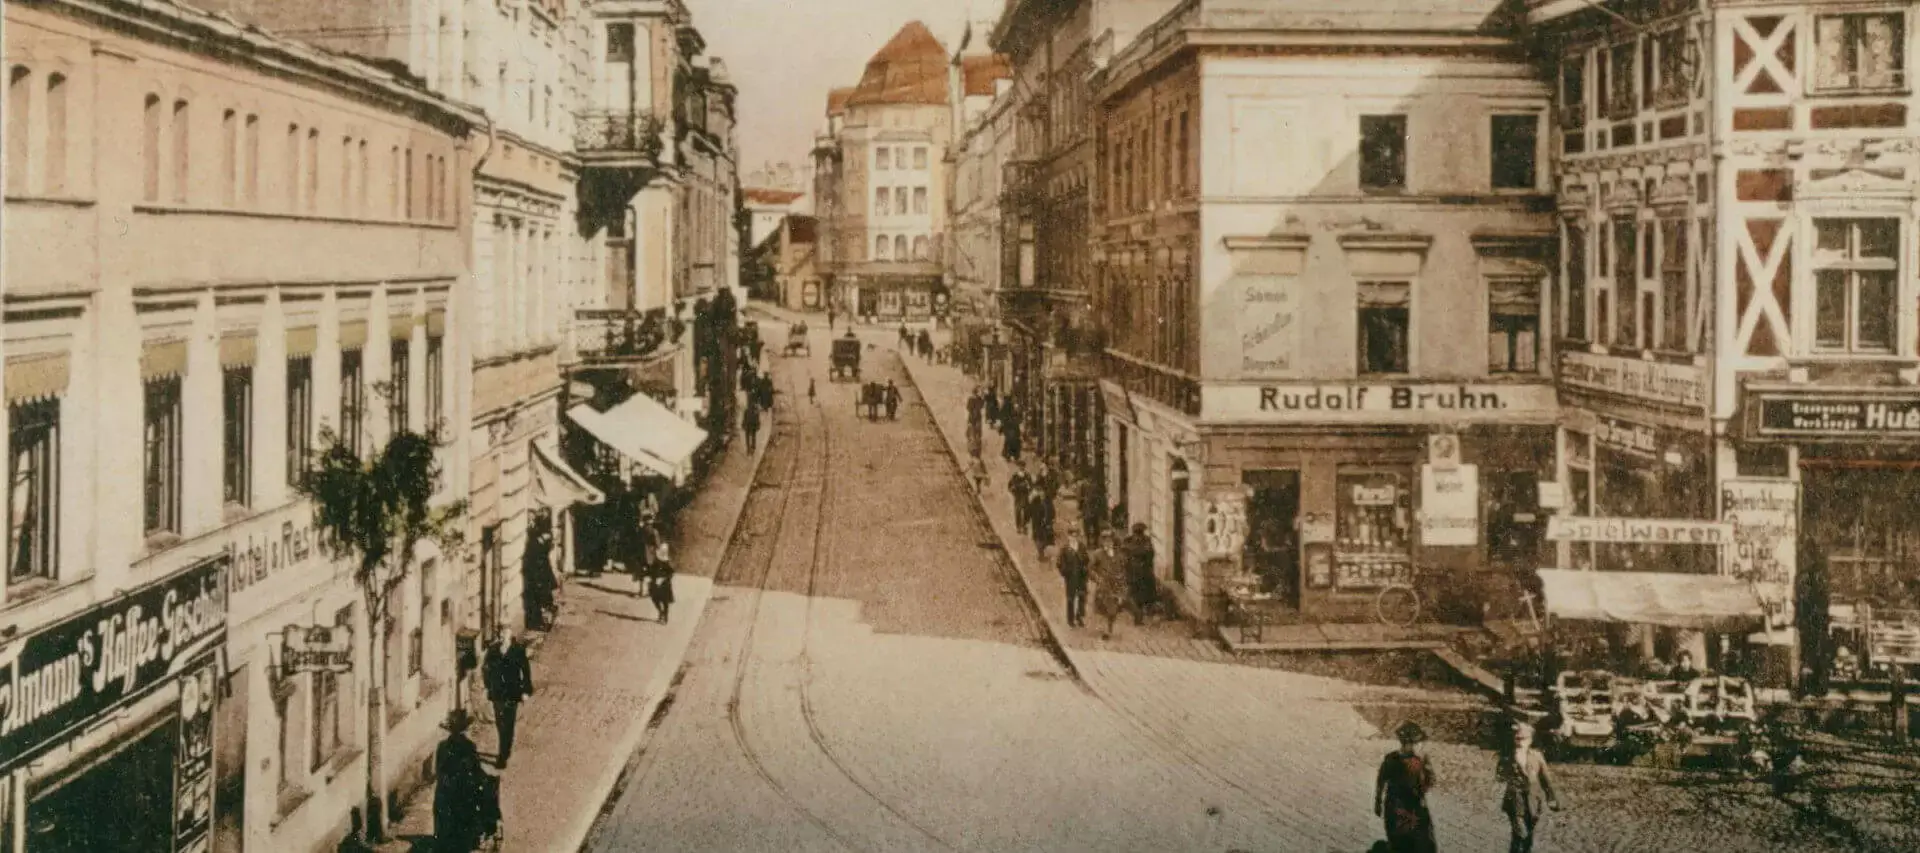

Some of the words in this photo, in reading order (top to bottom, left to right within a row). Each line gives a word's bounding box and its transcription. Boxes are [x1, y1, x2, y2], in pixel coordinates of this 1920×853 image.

[1259, 387, 1369, 410] Rudolf
[1390, 387, 1508, 410] Bruhn.
[1554, 519, 1723, 543] Spielwaren
